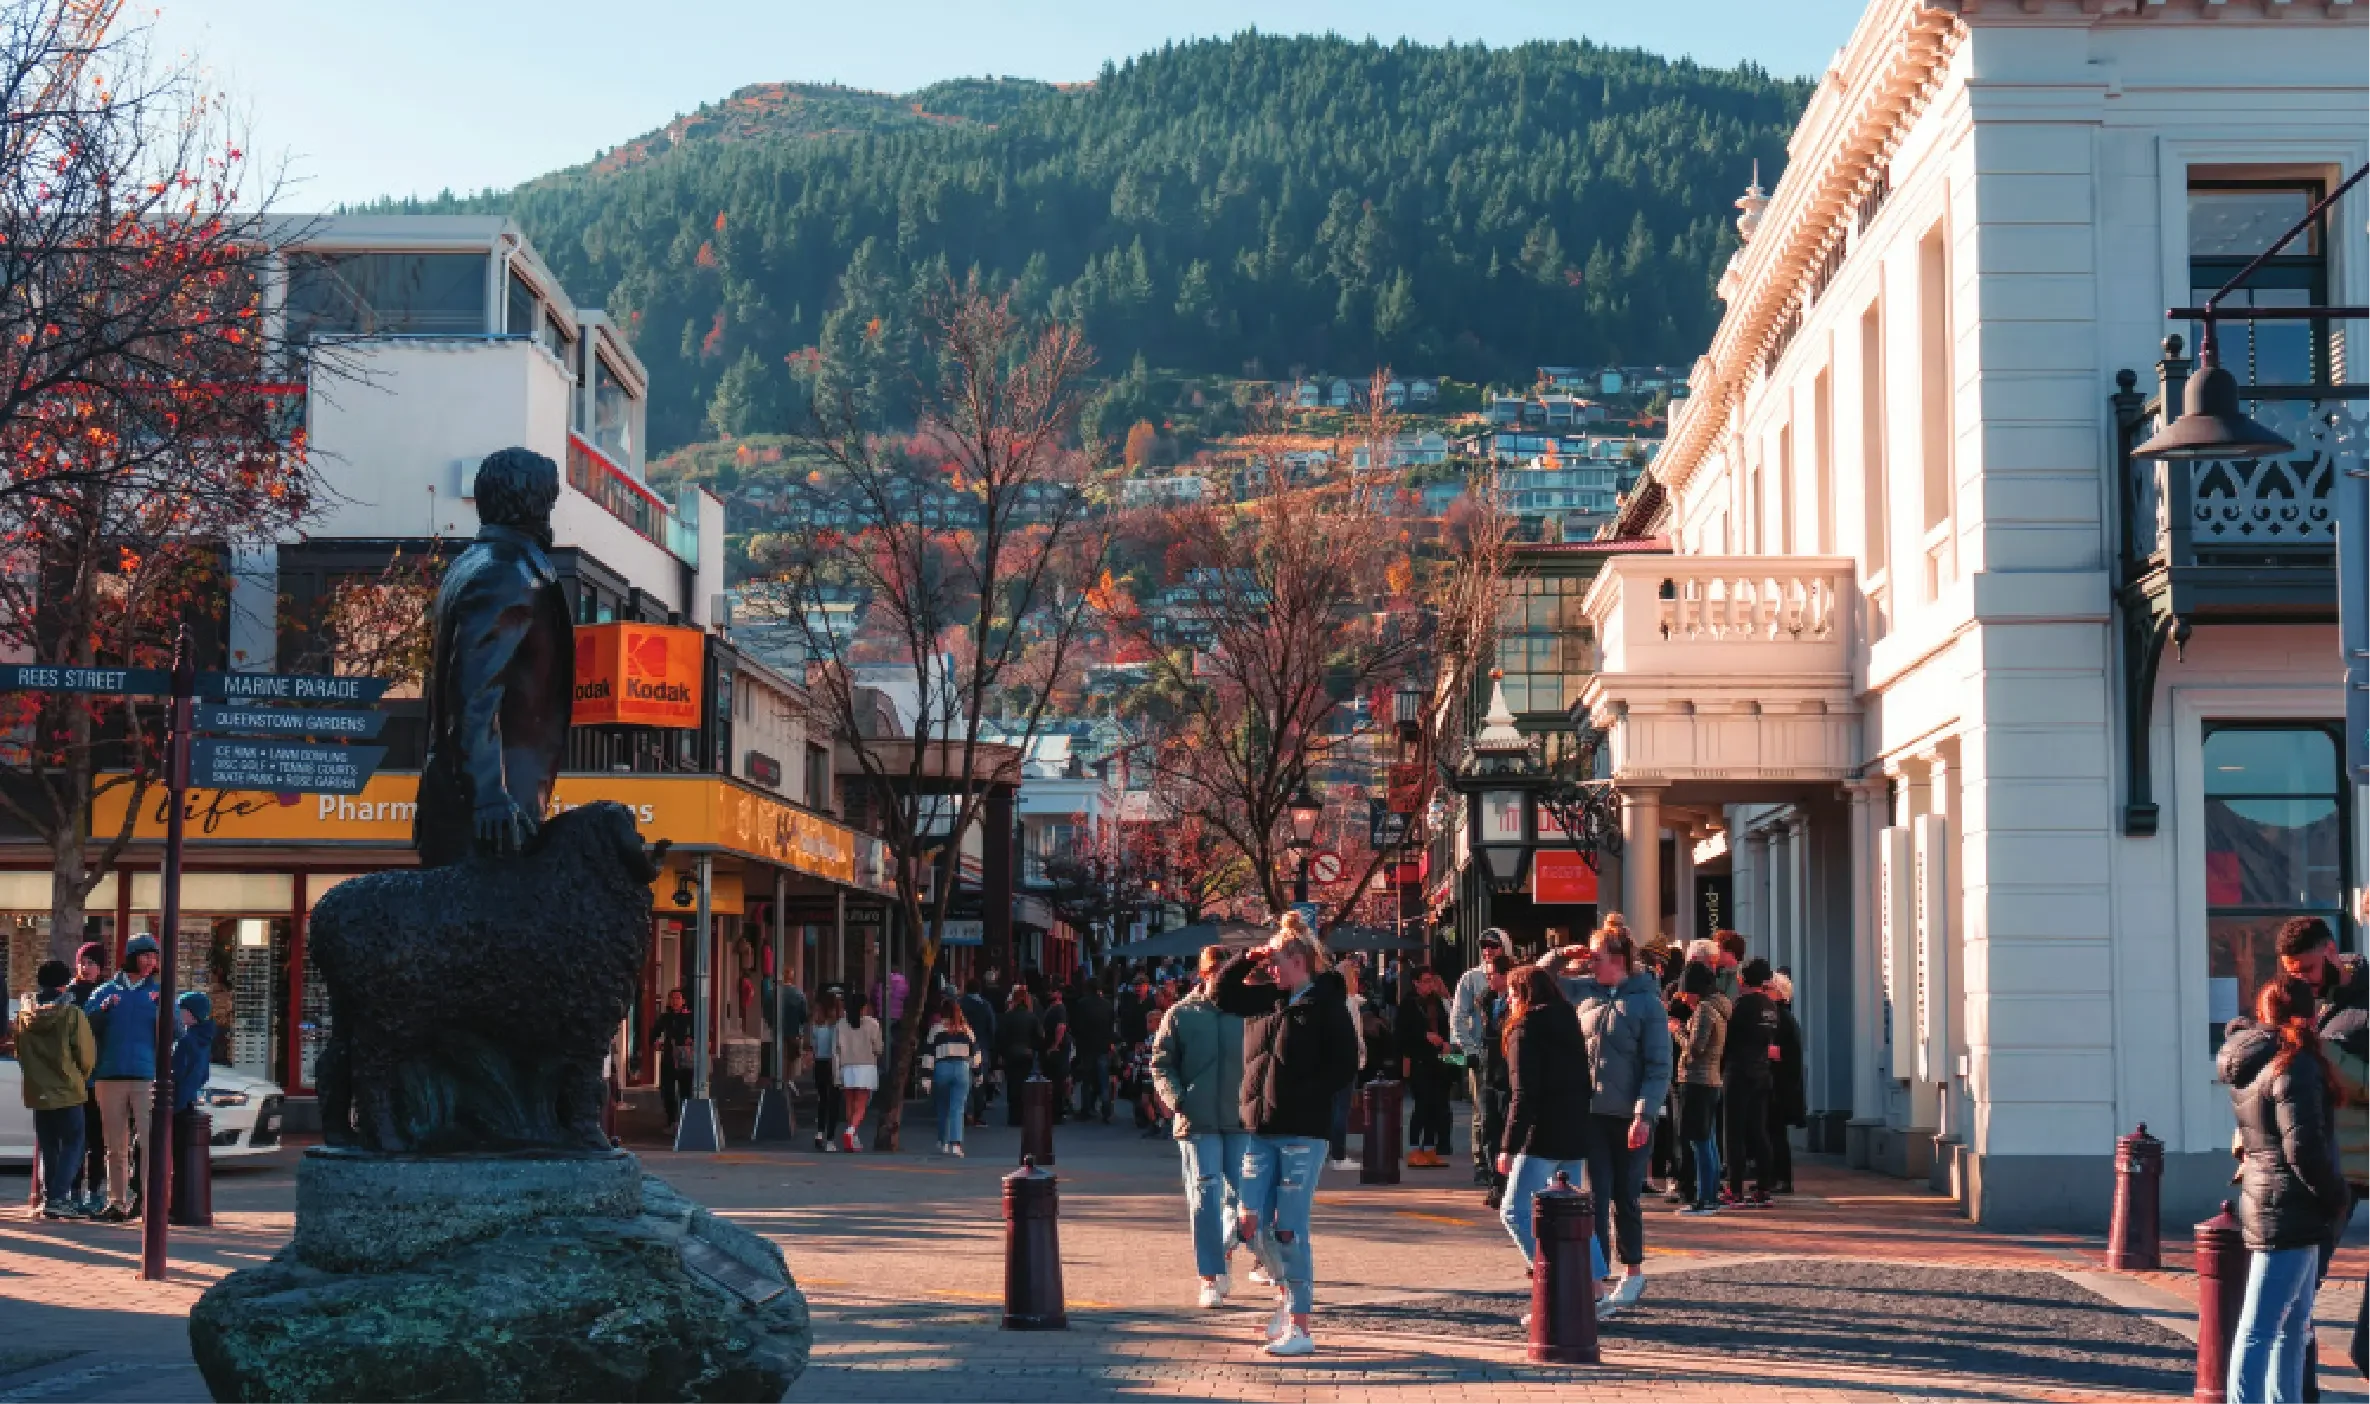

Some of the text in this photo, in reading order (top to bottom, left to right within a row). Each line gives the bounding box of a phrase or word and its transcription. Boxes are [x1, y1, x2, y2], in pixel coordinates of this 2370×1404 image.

[18, 667, 127, 690] REES STREET
[224, 676, 359, 699] MARINE PARADE
[575, 677, 612, 701] odak
[627, 677, 691, 702] Kodak
[215, 712, 366, 732] QUEENSTOWN GARDENS
[214, 745, 231, 757] ICE
[269, 748, 300, 761] LAWN
[300, 749, 348, 763] BOWLING
[212, 759, 358, 776] DISC GOLF TENNIS COURTS
[314, 775, 356, 789] GARDEN
